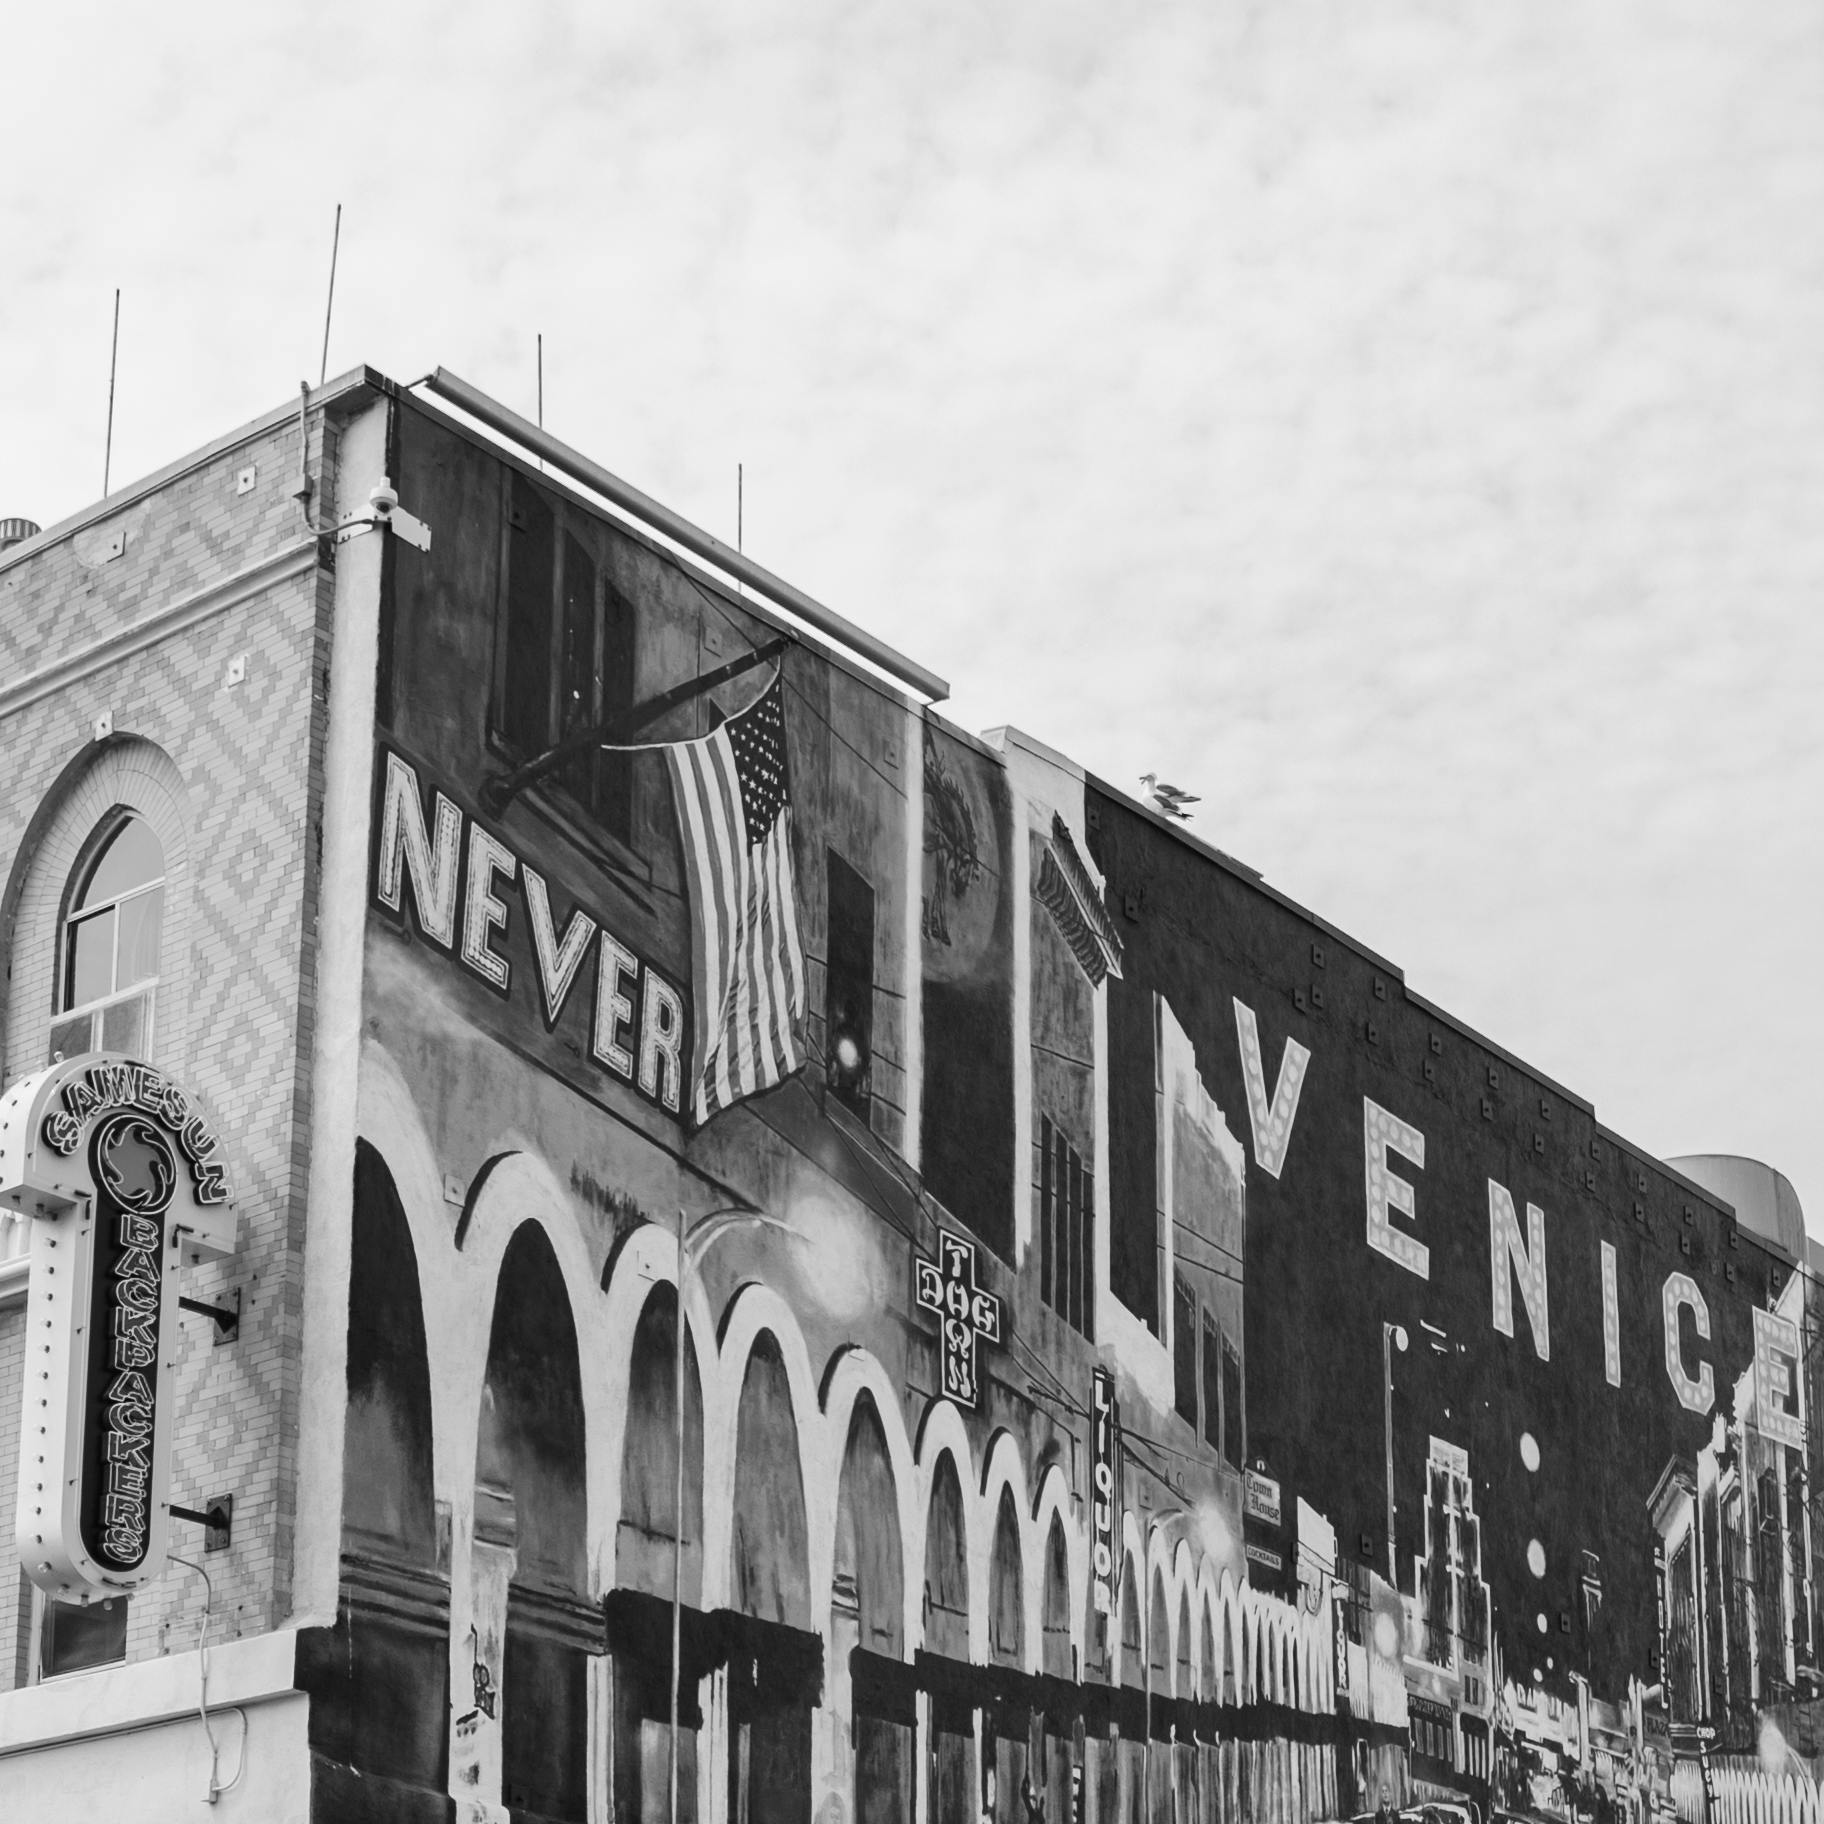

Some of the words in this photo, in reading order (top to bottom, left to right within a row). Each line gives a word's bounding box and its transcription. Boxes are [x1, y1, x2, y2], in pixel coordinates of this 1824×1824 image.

[378, 751, 683, 1112] NEVER
[42, 1064, 233, 1204] SAMESUN
[1232, 996, 1806, 1452] VENICE
[102, 1214, 161, 1563] BACKPACKERS
[1093, 1379, 1113, 1614] LIQUOR
